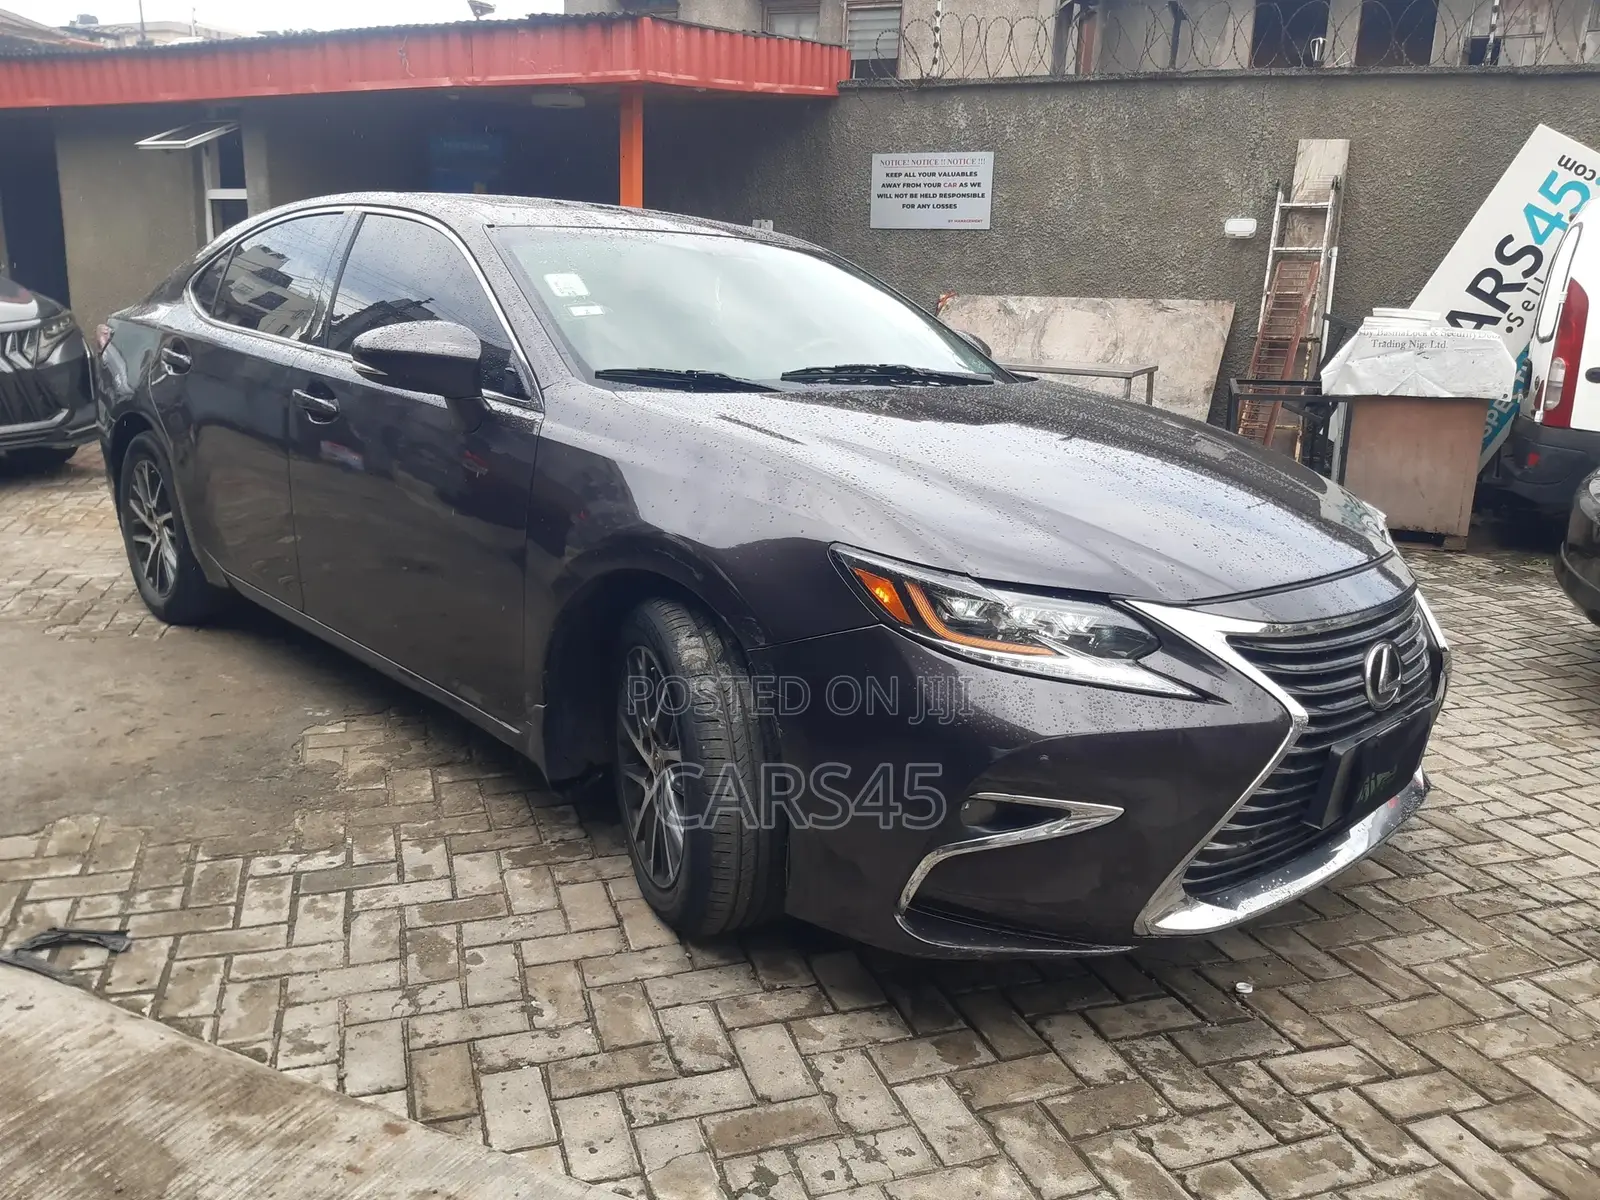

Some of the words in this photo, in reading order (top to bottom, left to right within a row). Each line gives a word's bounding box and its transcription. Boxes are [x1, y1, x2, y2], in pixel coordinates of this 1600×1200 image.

[1446, 170, 1590, 330] ARS45
[1371, 339, 1406, 350] Trading
[1409, 339, 1427, 350] Nig.
[1430, 340, 1448, 349] Ltd.
